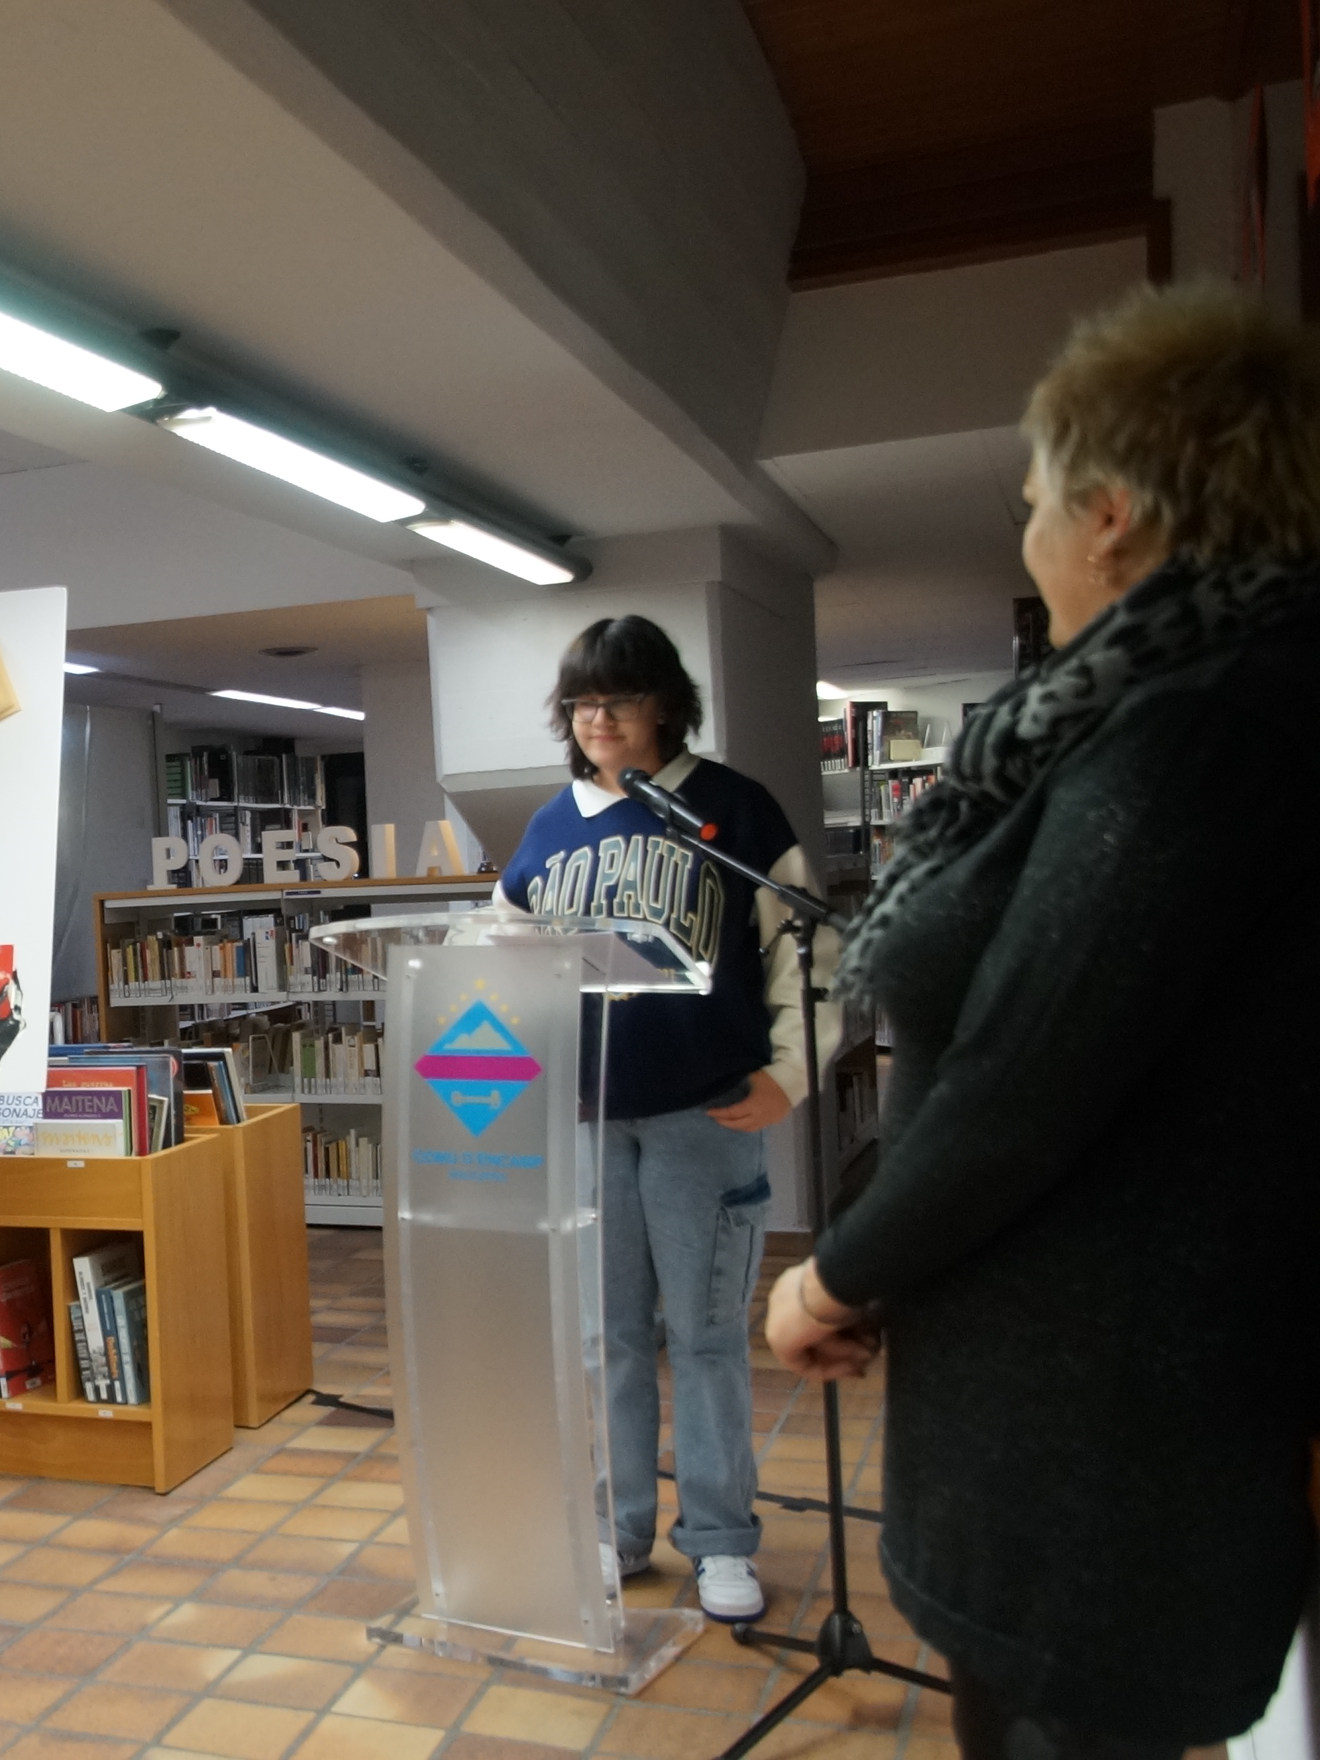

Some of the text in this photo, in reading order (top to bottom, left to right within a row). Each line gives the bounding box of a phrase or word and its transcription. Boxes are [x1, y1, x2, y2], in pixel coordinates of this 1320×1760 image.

[147, 820, 465, 890] POESIA
[591, 834, 726, 971] PAULO
[46, 1095, 118, 1113] MAITENA
